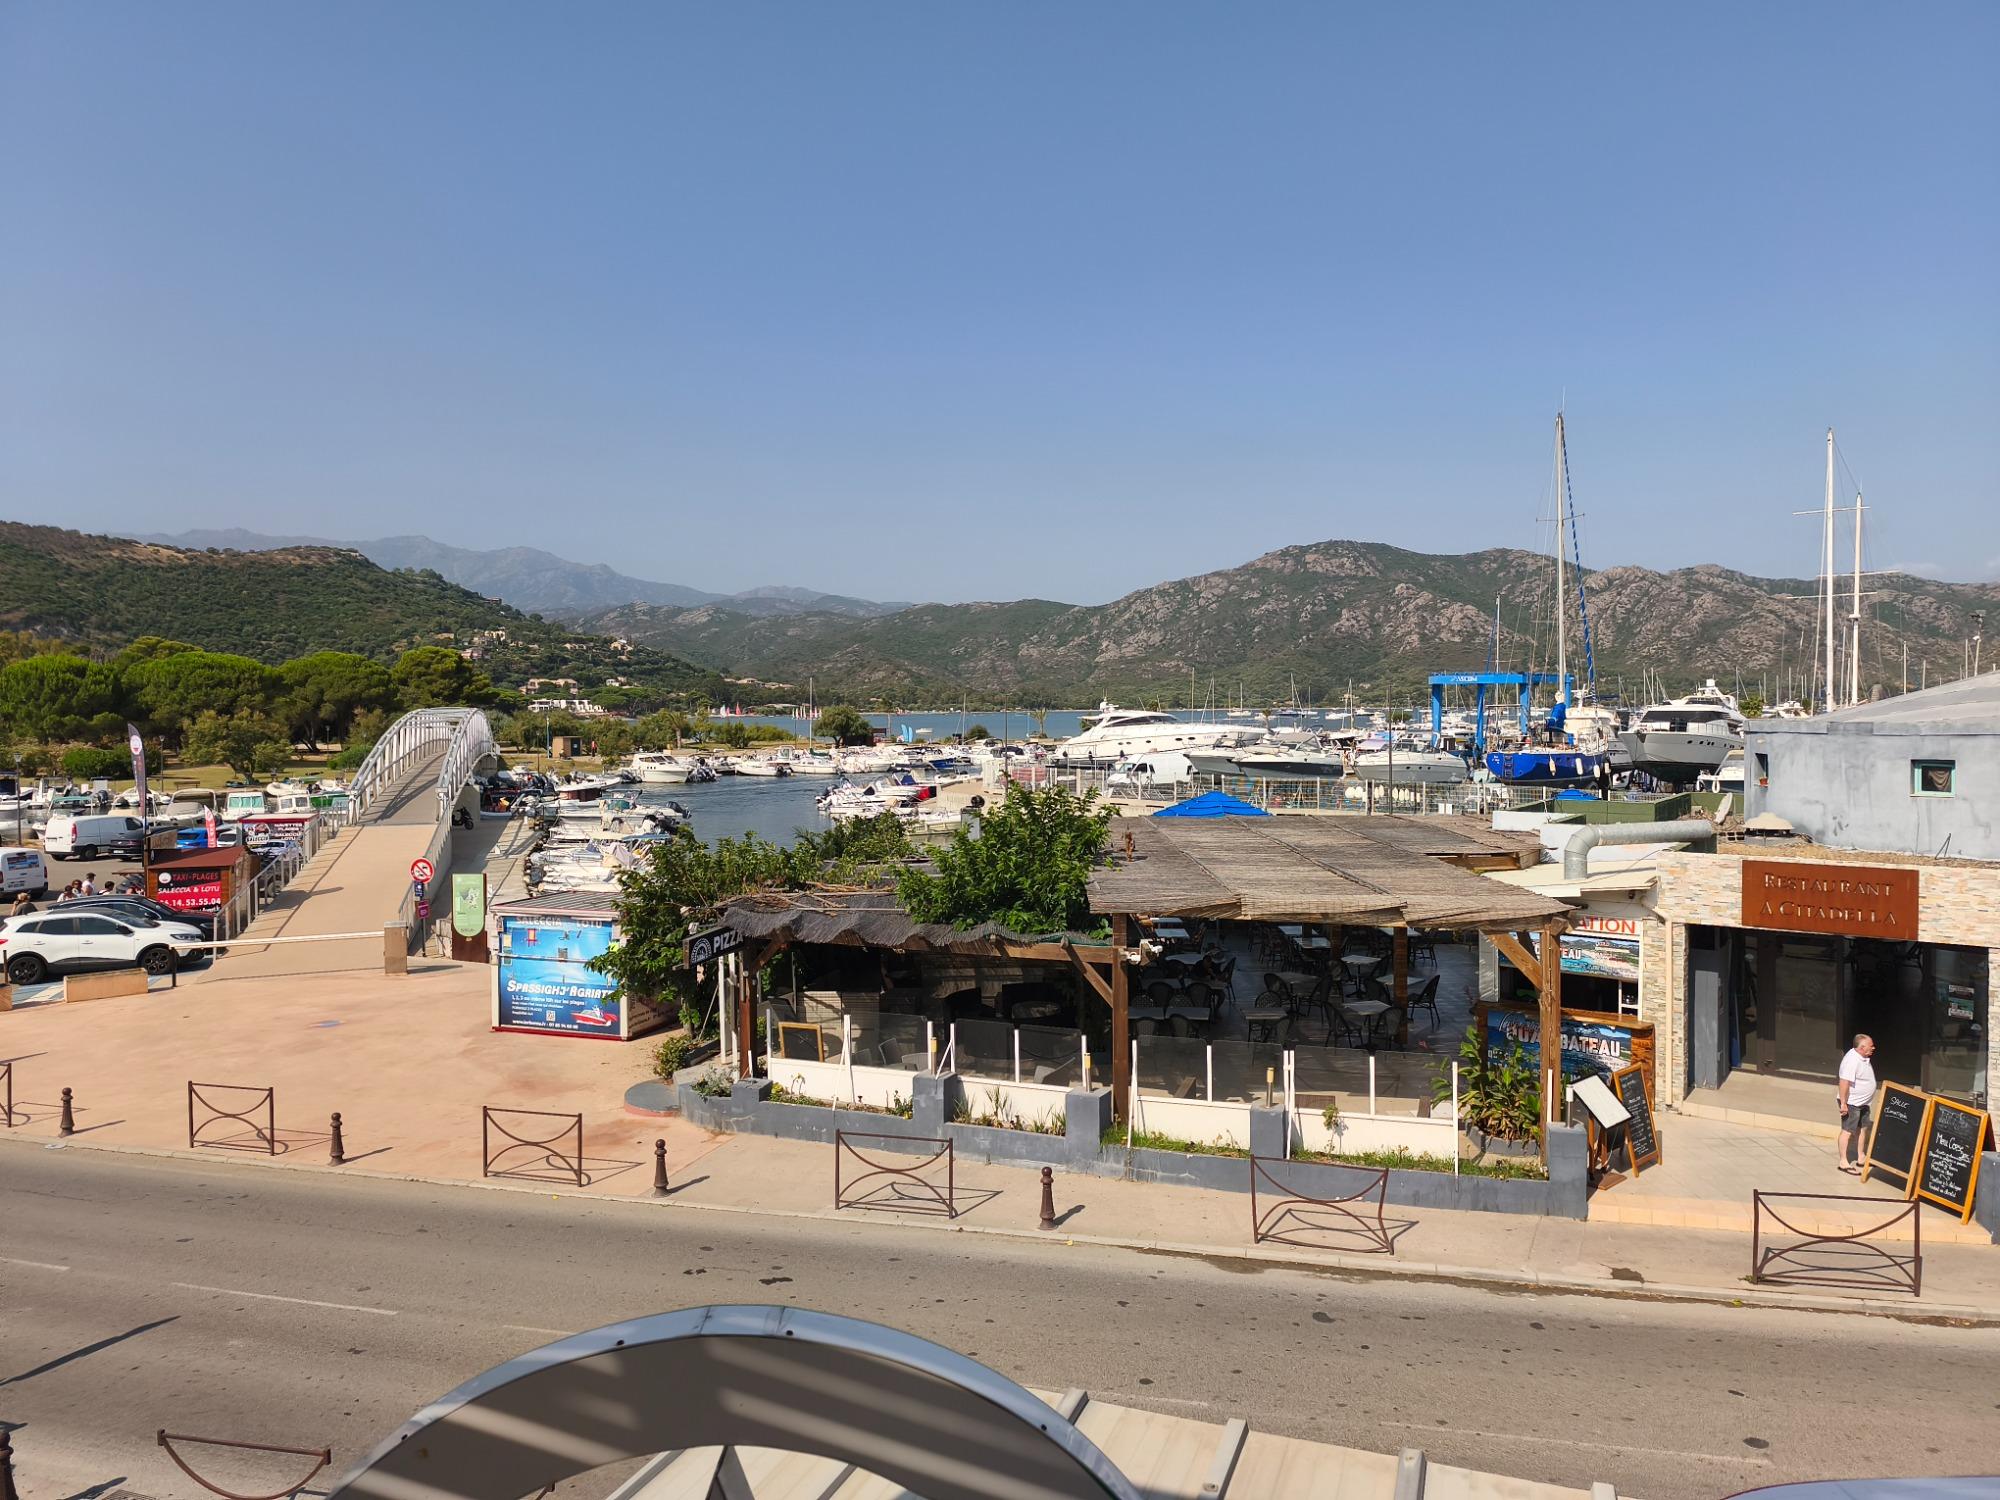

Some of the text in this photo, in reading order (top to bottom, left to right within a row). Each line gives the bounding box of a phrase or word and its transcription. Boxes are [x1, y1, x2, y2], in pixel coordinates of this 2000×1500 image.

[1764, 873, 1894, 897] RESTAURANT
[1579, 916, 1636, 934] ATION
[1760, 900, 1897, 926] A CITADELLA
[713, 929, 744, 953] PIZZA
[1560, 1034, 1621, 1057] BATEAU
